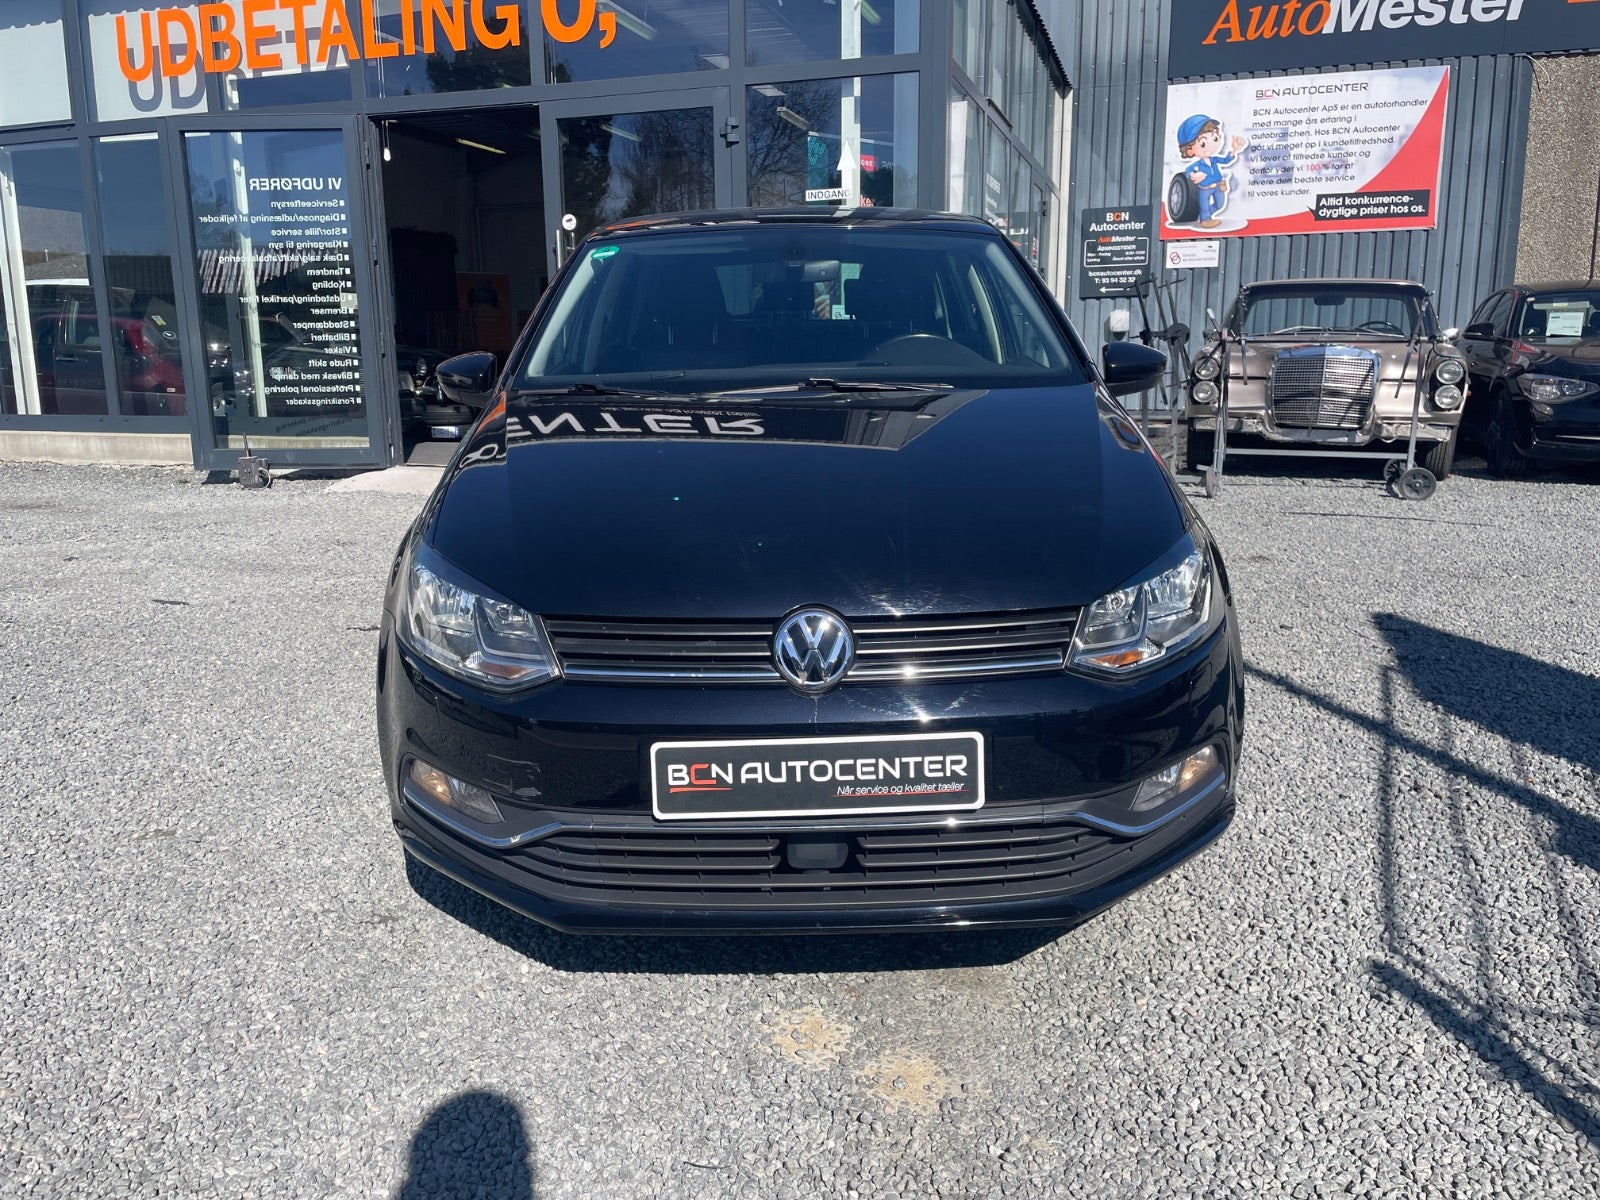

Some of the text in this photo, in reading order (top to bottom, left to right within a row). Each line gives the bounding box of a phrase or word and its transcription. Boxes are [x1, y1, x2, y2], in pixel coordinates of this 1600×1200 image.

[1201, 0, 1523, 45] AutoMester
[114, 0, 521, 82] UDBETALING
[1255, 82, 1369, 99] BCN AUTOCENTER
[1252, 108, 1271, 117] BCN
[1273, 105, 1320, 116] Autocenter
[1321, 104, 1339, 113] ApS
[1364, 98, 1429, 109] autoforhandler
[1252, 119, 1272, 129] med
[1273, 118, 1303, 128] mange
[1305, 116, 1318, 125] års
[1320, 114, 1353, 125] erfaring
[1251, 124, 1401, 140] autobranchen. Hos BCN Autocenter
[1266, 143, 1274, 151] vi
[1276, 141, 1303, 151] meget
[1304, 141, 1316, 150] op
[1322, 136, 1396, 148] kundetilfredshed.
[1250, 155, 1259, 163] Vi
[1260, 154, 1281, 162] lever
[1292, 152, 1325, 161] tilfredse
[1327, 149, 1357, 160] kunder
[1358, 150, 1371, 159] og
[1249, 166, 1273, 175] derfor
[1275, 165, 1295, 176] yder
[1296, 164, 1304, 172] vi
[1306, 163, 1321, 172] 100
[1344, 161, 1354, 170] at
[1248, 173, 1356, 187] levere den bedste service
[806, 189, 851, 200] INDGANG
[1247, 190, 1255, 198] til
[1256, 189, 1279, 197] vores
[1319, 194, 1415, 207] Altid konkurrence-
[1105, 211, 1130, 222] BCN
[1318, 204, 1426, 219] dygtige priser hos os.
[1089, 220, 1146, 232] Autocenter
[1088, 268, 1143, 278] bcnautocenter.dk
[667, 754, 968, 786] BCN AUTOCENTER
[836, 781, 965, 796] Når service og kvalitet tæller
